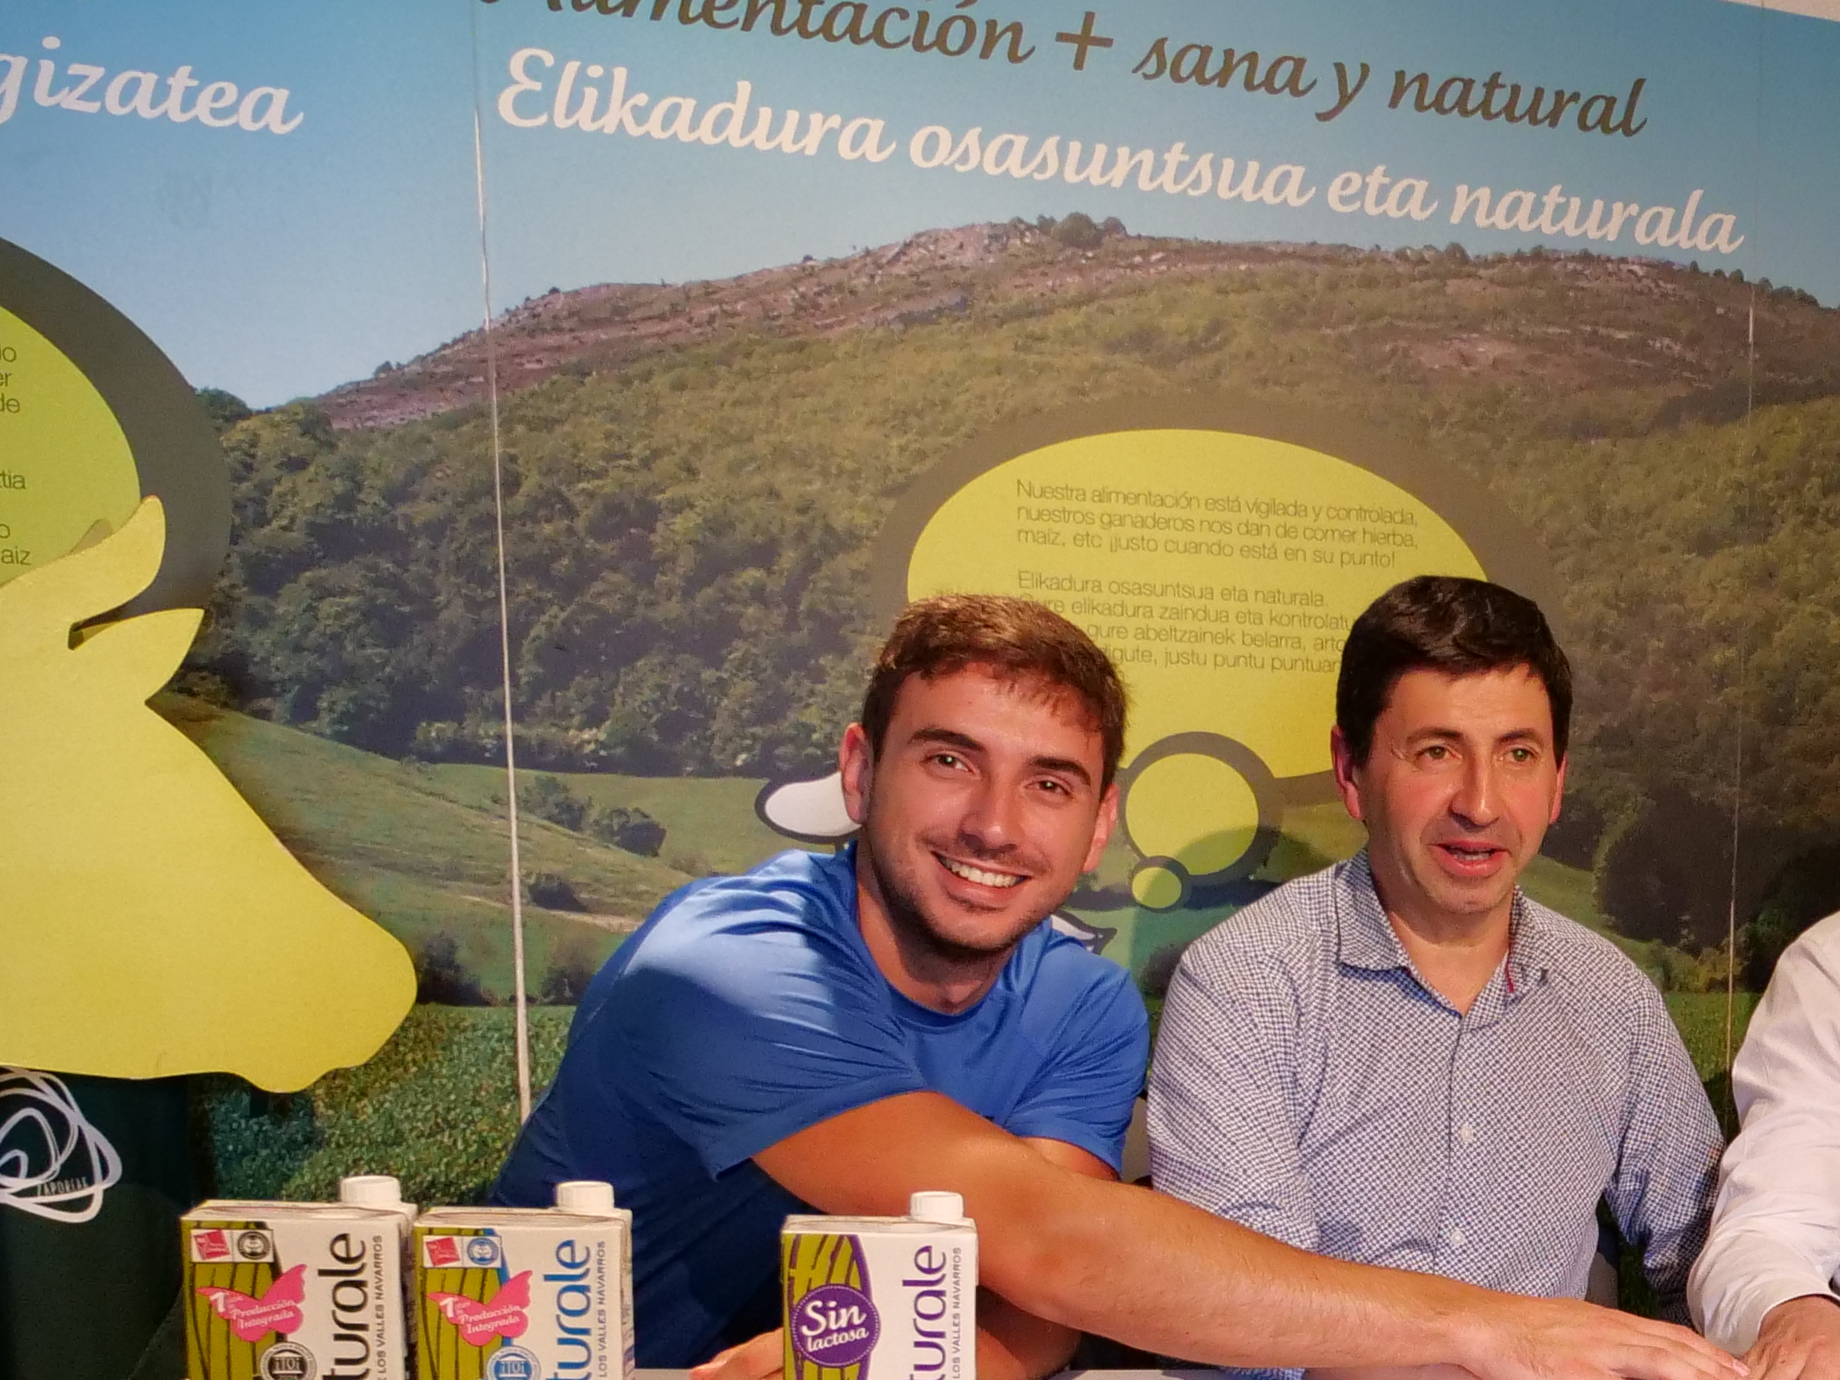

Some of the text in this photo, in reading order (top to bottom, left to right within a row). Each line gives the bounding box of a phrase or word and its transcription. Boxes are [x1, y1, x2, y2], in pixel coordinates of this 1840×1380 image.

[478, 0, 1648, 137] mentación + sana y natural
[498, 46, 1745, 255] Elikadura osasuntsua eta naturala
[1016, 479, 1087, 502] Nuestra
[1091, 487, 1200, 510] alimentación
[1204, 494, 1241, 514] está
[1246, 497, 1308, 519] vigilada
[1312, 505, 1323, 523] y
[1016, 505, 1096, 526] nuestros
[1099, 511, 1195, 533] ganaderos
[1200, 518, 1232, 535] nos
[1237, 519, 1271, 538] dan
[1275, 522, 1298, 540] de
[1303, 527, 1358, 544] comer
[1073, 530, 1102, 548] etc
[1164, 538, 1234, 558] cuando
[1240, 543, 1278, 560] está
[1284, 547, 1307, 562] en
[1313, 549, 1335, 564] su
[1340, 551, 1396, 568] punto!
[1018, 570, 1103, 593] Elikadura
[1108, 579, 1214, 602] osasuntsua
[1220, 586, 1248, 601] eta
[1071, 598, 1154, 619] elikadura
[1159, 604, 1230, 623] zaindua
[1235, 609, 1264, 625] eta
[1164, 649, 1208, 668] justu
[1213, 653, 1265, 670] puntu
[801, 1299, 866, 1337] Sin
[806, 1326, 870, 1354] lactosa
